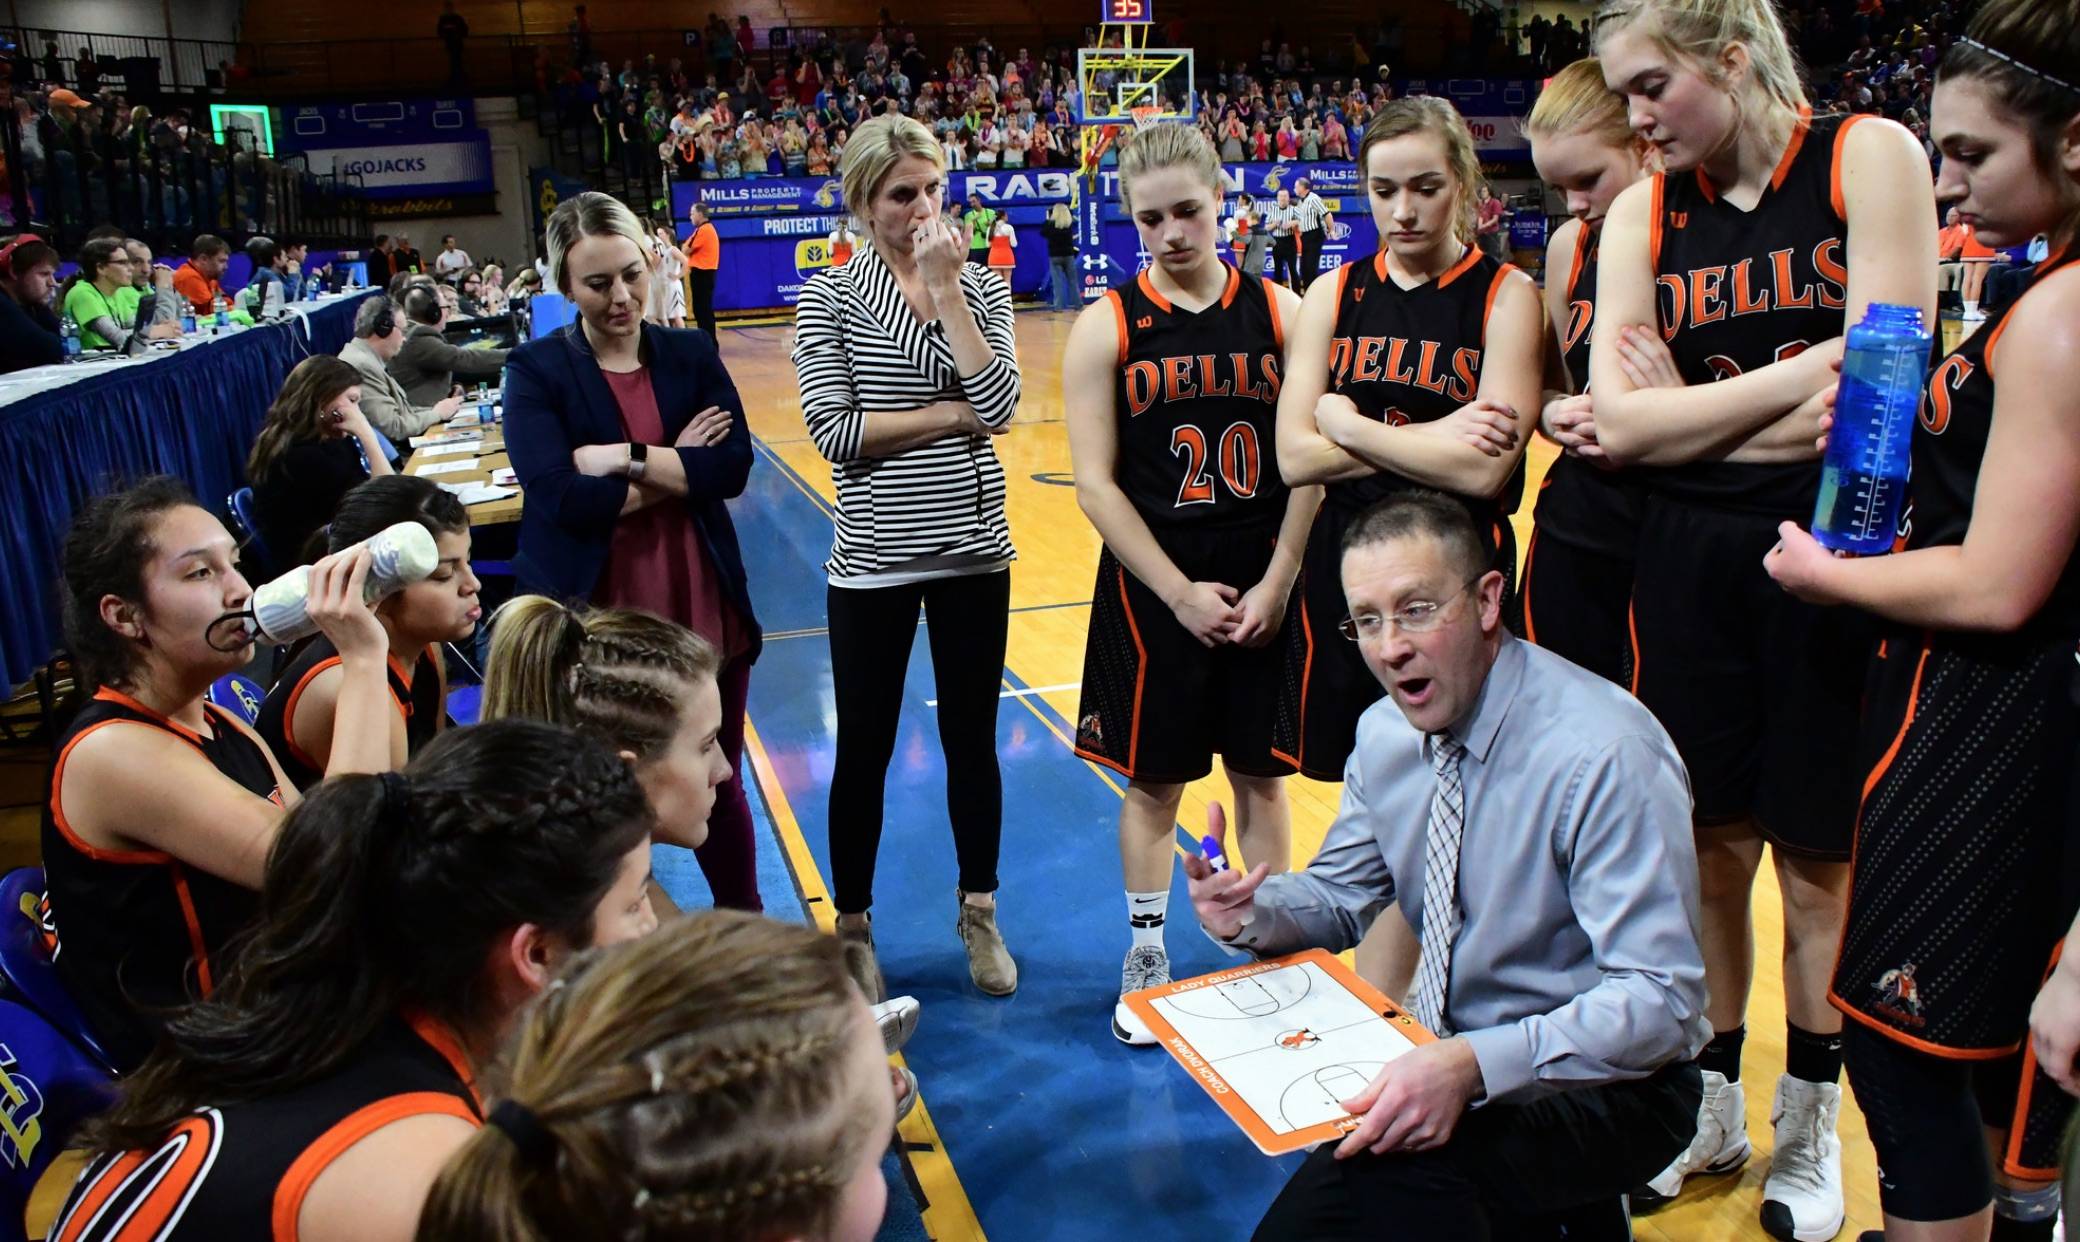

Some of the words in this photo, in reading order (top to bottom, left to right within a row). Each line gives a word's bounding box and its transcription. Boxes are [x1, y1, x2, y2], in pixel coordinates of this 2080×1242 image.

[701, 188, 749, 201] MILLS
[764, 217, 818, 235] PROTECT
[1096, 276, 1108, 284] LG
[1657, 237, 1848, 343] DELLS
[1125, 353, 1281, 417] DELLS
[1170, 421, 1261, 508] 20
[1171, 979, 1206, 993] LADY
[1208, 962, 1282, 983] QUARRIERS
